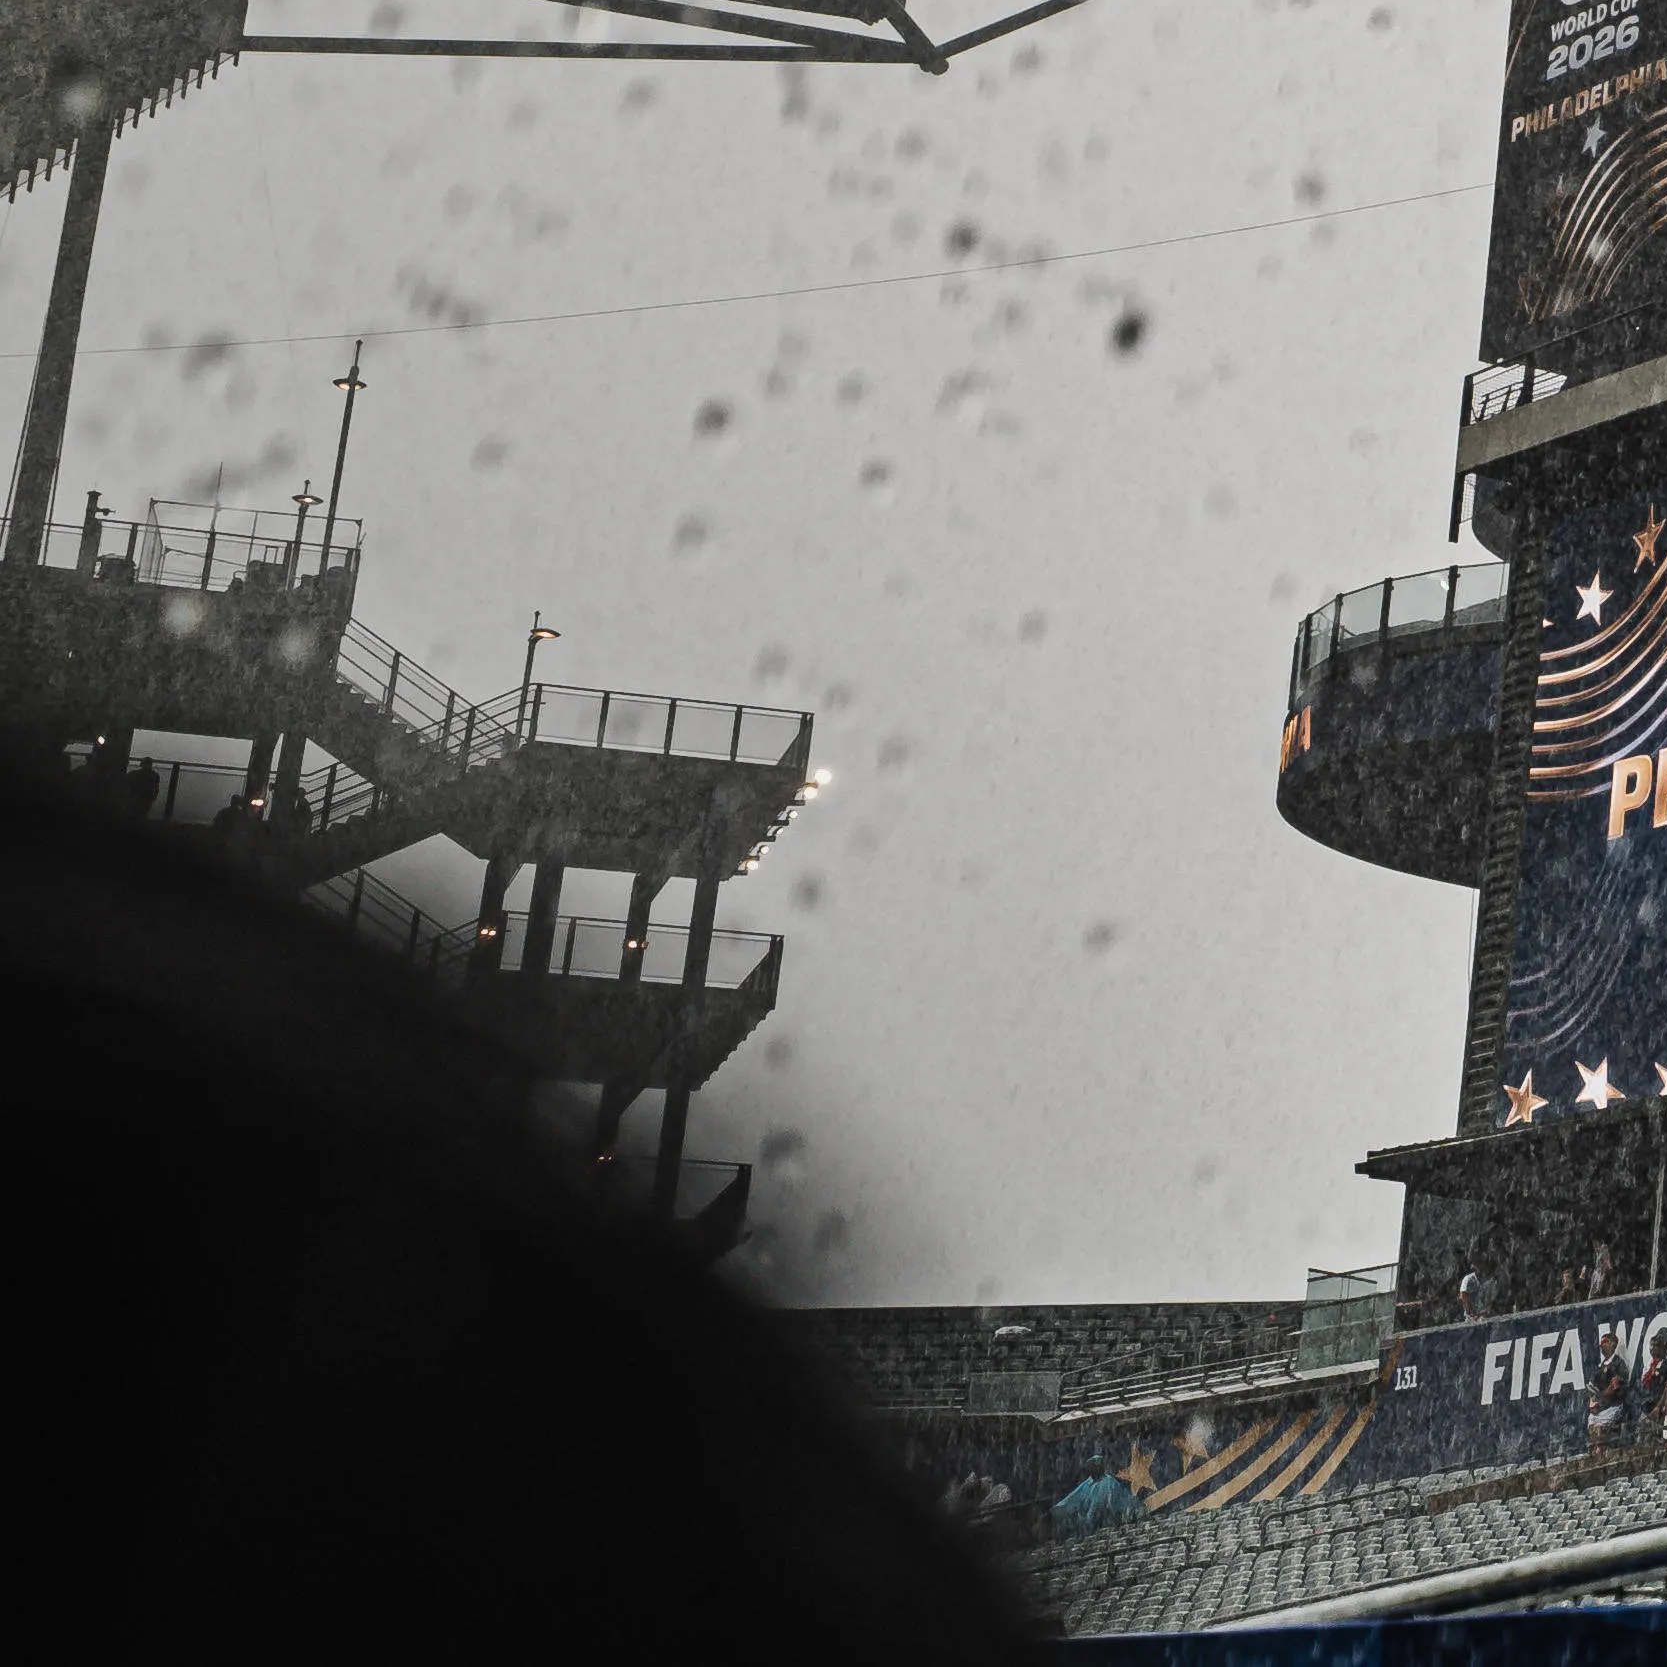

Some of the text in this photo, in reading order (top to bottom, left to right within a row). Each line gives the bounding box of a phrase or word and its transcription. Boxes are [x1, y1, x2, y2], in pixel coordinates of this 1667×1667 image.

[1546, 15, 1640, 81] 2026
[1550, 4, 1608, 42] WORLD
[1511, 56, 1667, 143] PHILADELPHIA
[1394, 1365, 1418, 1391] 131
[1481, 1329, 1585, 1405] FIFA
